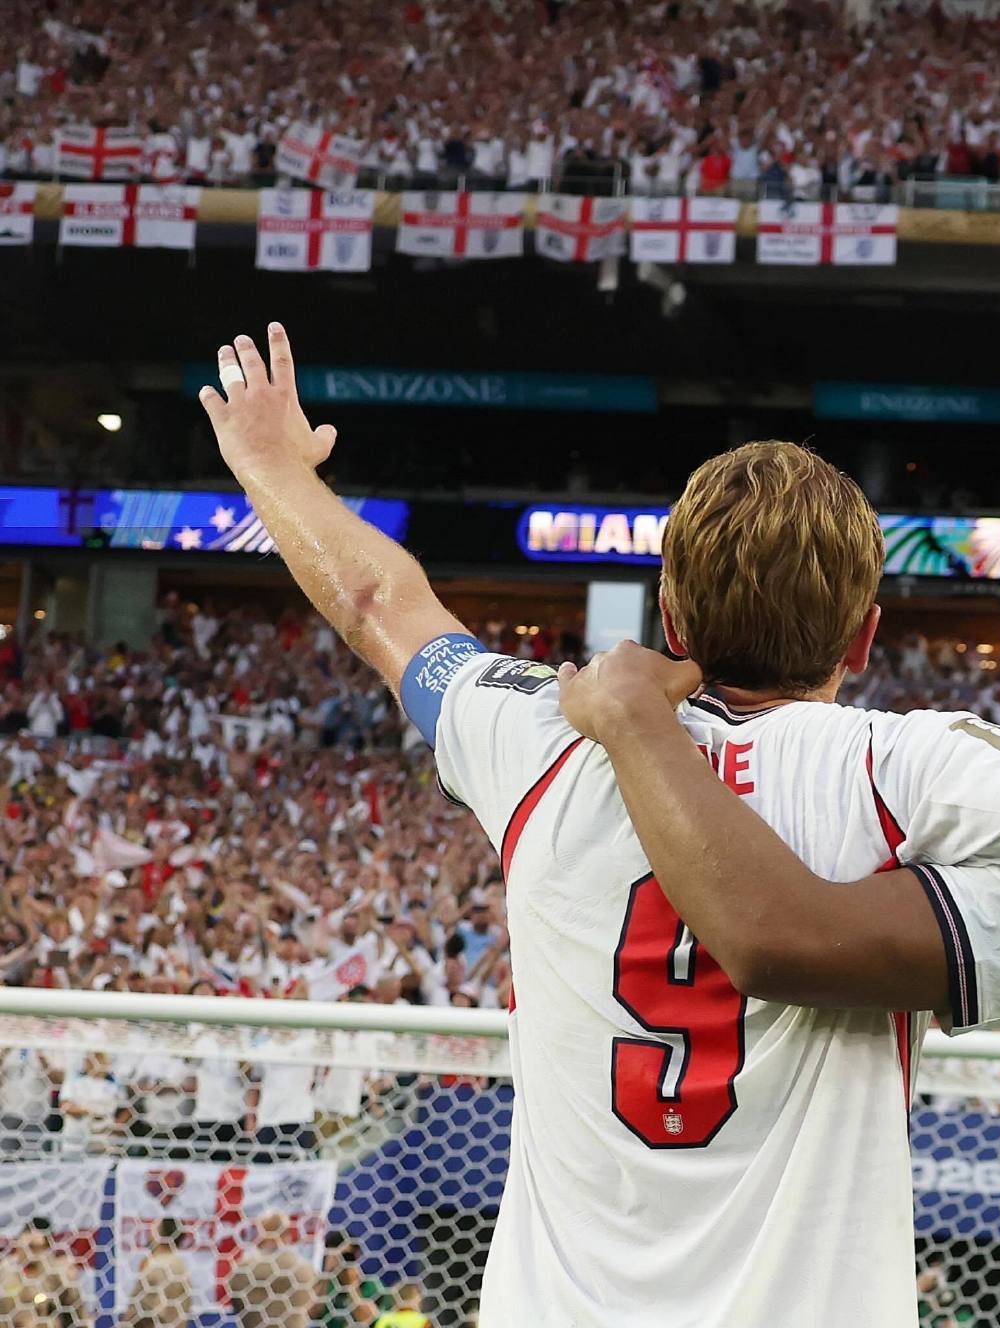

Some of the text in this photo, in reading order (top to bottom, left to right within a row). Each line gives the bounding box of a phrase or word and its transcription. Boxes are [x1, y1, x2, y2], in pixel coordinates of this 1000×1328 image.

[325, 371, 507, 402] ENDZONE
[528, 511, 671, 555] MIAM
[415, 646, 454, 688] World
[612, 870, 749, 1150] 9
